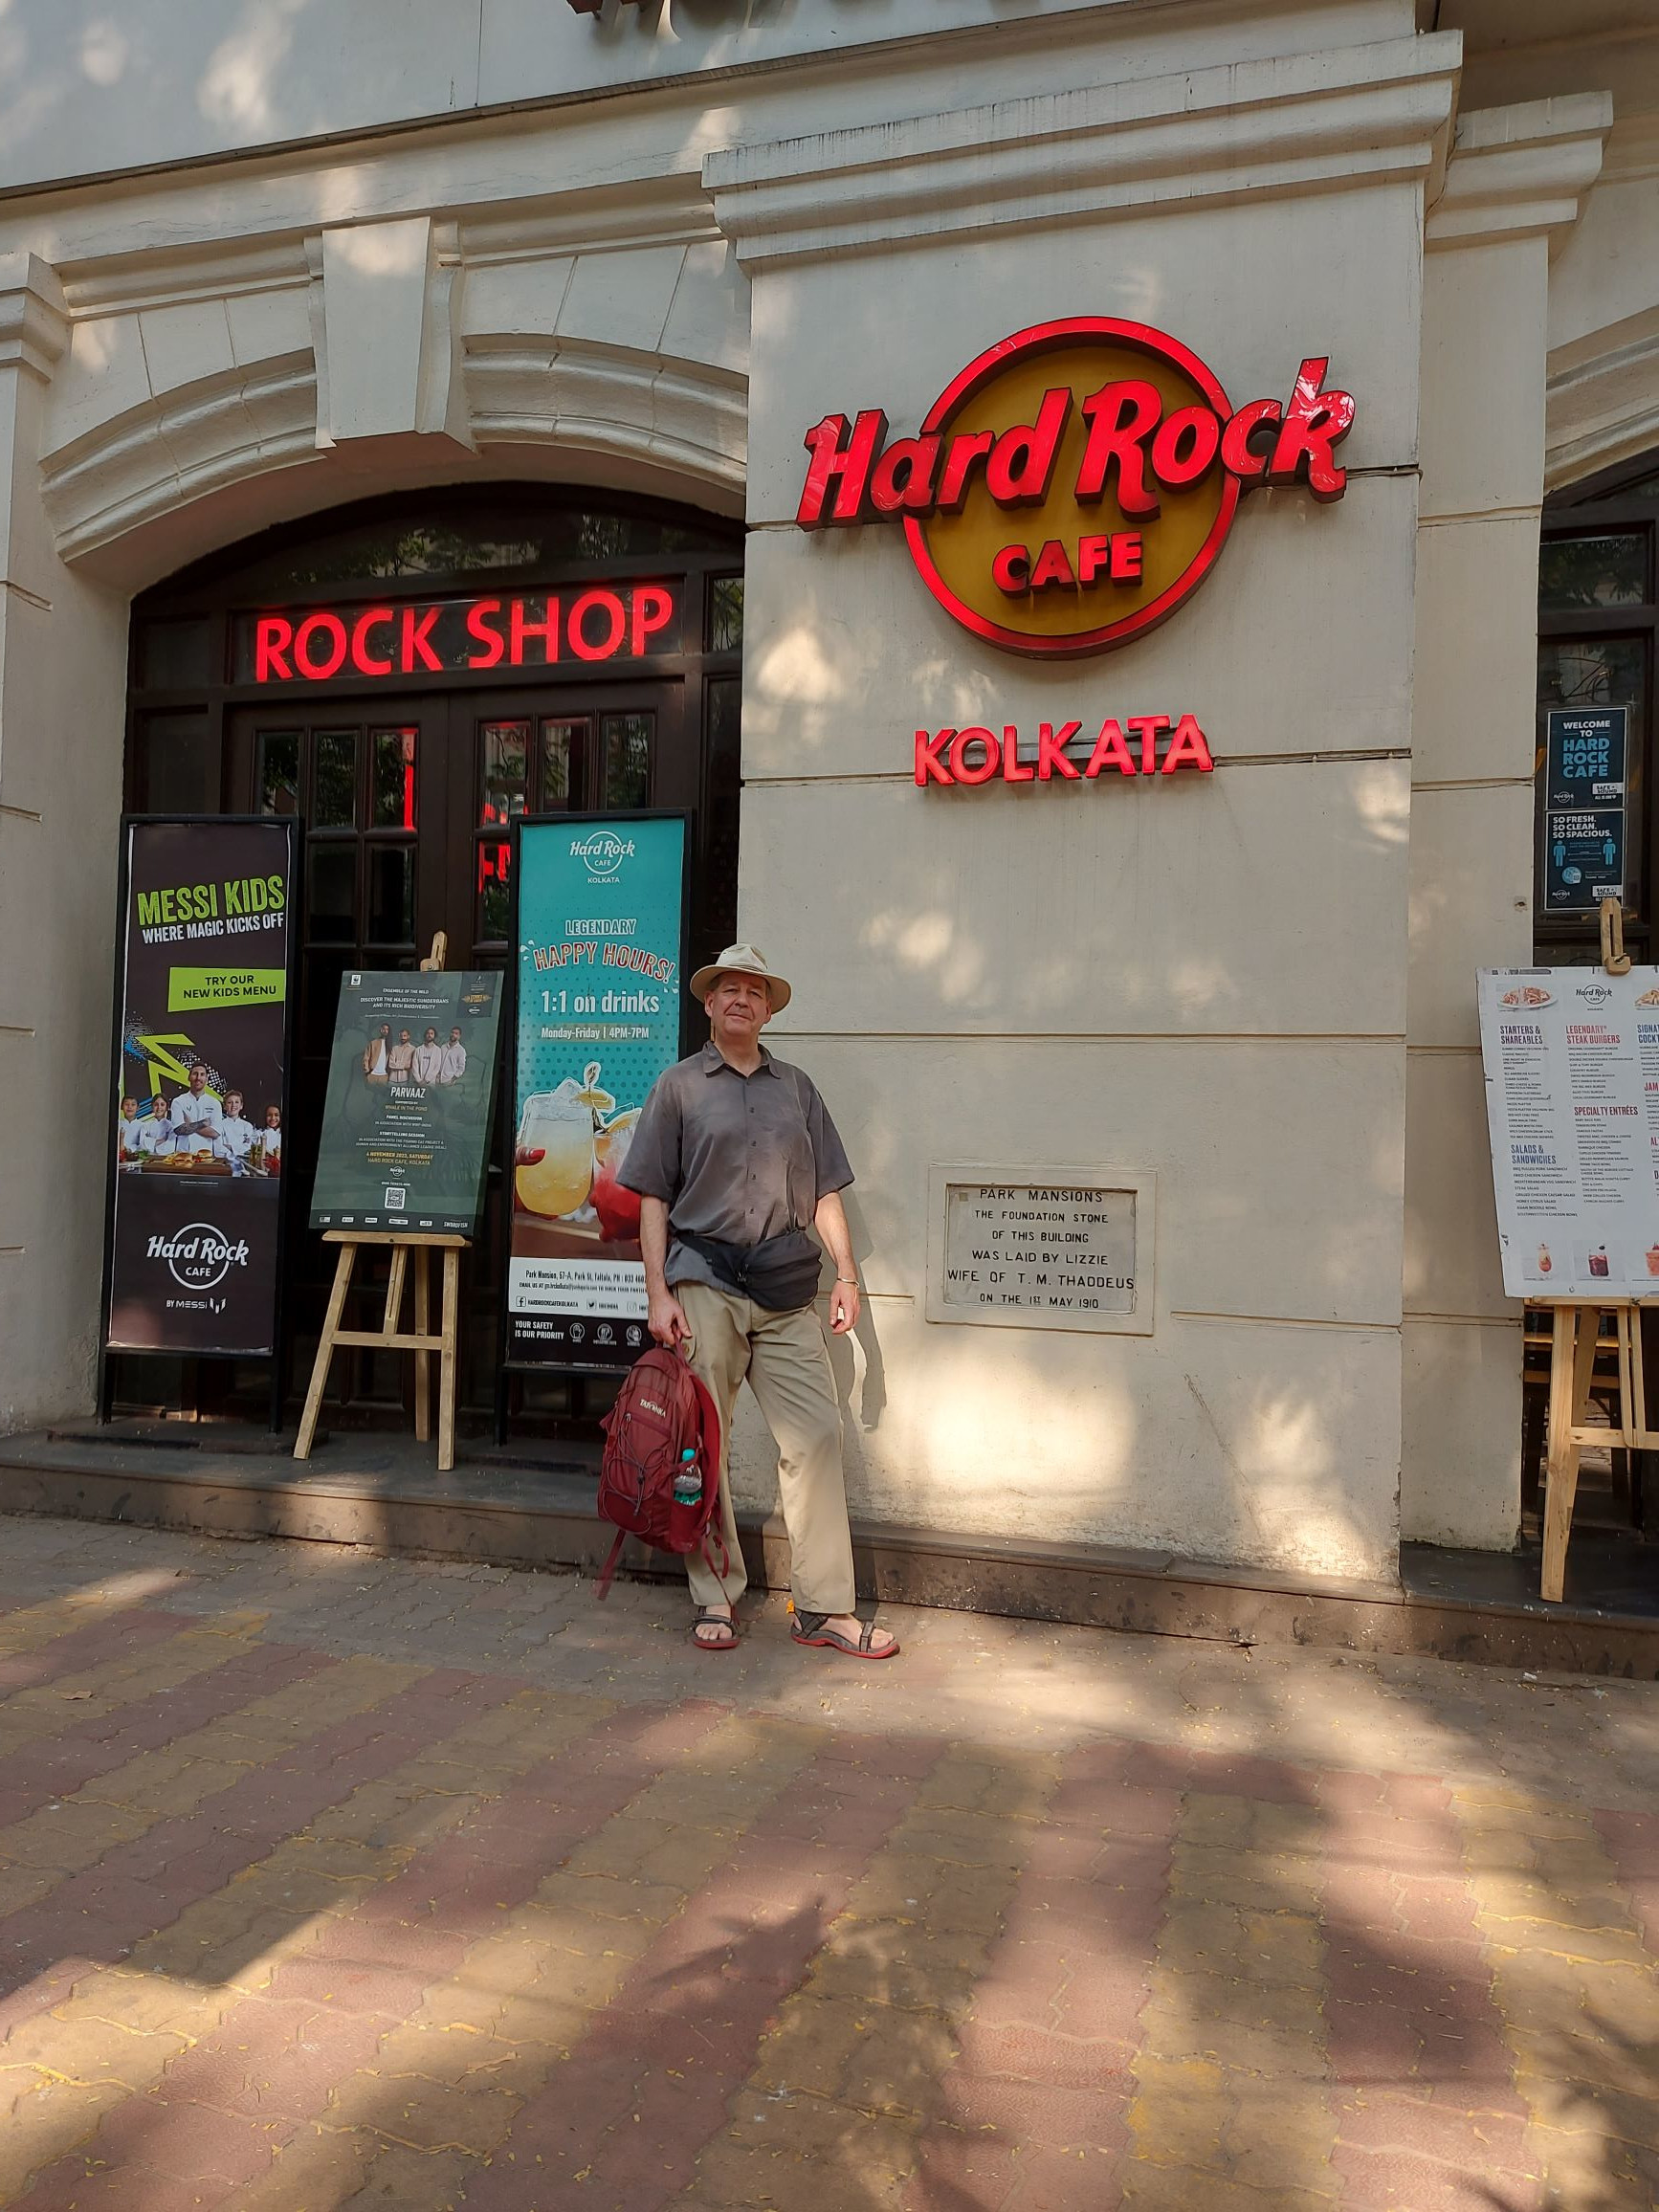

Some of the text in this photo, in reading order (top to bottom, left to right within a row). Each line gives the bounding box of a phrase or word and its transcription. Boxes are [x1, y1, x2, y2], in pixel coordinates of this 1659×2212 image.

[796, 356, 1356, 532] Hard Rock
[992, 531, 1143, 598] CAFE
[255, 587, 674, 682] ROCK SHOP
[1563, 720, 1611, 730] WELCOME
[914, 714, 1214, 786] KOLKATA
[1563, 738, 1610, 752] HARD
[1563, 751, 1609, 765] ROCK
[1562, 764, 1608, 779] CAFE
[1566, 830, 1612, 838] SPACIOUS.
[569, 840, 635, 857] Hard Rock
[138, 875, 285, 926] MESSI KIDS
[143, 912, 284, 944] WHERE MAGIC KICKS OFF
[564, 918, 636, 936] LEGENDARY
[533, 941, 675, 984] HAPPY HOURS!
[205, 975, 254, 985] TRY OUR
[183, 985, 276, 999] NEW KIDS MENU
[542, 990, 659, 1012] 1:1 on drinks
[541, 1027, 649, 1039] Monday-Friday 4PM-7PM
[1500, 1026, 1540, 1034] STARTERS &
[1501, 1035, 1543, 1044] SHAREABLES
[1567, 1035, 1621, 1044] STEAK BURGERS
[390, 1087, 426, 1098] PARVAAZ
[1575, 1105, 1639, 1116] SPECIALTY ENTRÉES
[1511, 1144, 1544, 1154] SALADS &
[1512, 1156, 1557, 1164] SANDWICHES
[980, 1188, 1103, 1203] PARK MANSIONS
[974, 1210, 1109, 1224] THE FOUNDATION STONE
[992, 1230, 1089, 1243] OF THIS BUILDING
[146, 1236, 249, 1266] Hard Rock
[972, 1250, 1109, 1265] WAS LAID BY LIZZIE
[186, 1268, 211, 1277] CAFE
[526, 1271, 537, 1279] Park
[538, 1271, 559, 1281] Mansion,
[574, 1272, 585, 1281] Park
[947, 1270, 1135, 1290] WIFE OF T. M. THADDEUS
[980, 1294, 993, 1302] ON
[1001, 1294, 1022, 1304] THE
[1049, 1297, 1073, 1307] MAY
[1079, 1299, 1099, 1309] 1910
[515, 1320, 554, 1330] YOUR SAFETY
[522, 1330, 536, 1338] OUR
[536, 1331, 564, 1340] PRIORITY
